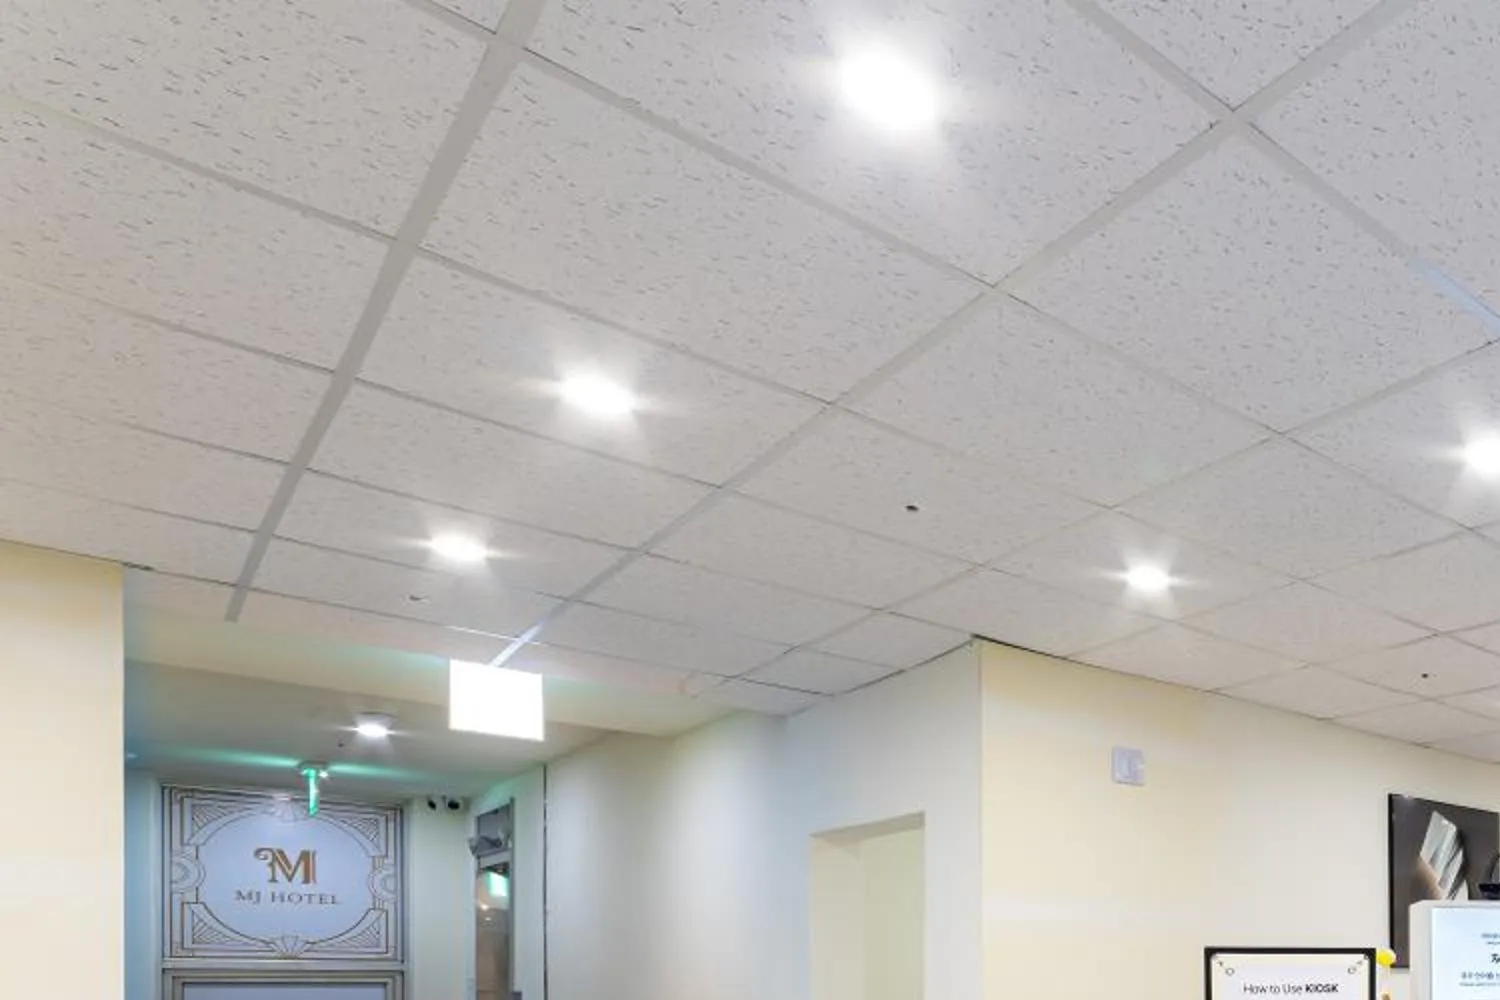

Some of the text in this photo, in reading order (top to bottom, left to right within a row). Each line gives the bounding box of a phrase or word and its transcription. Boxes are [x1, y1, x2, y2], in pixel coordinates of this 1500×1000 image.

[235, 890, 342, 905] MJ HOTEL
[1243, 983, 1340, 994] How to Use KIOSK
